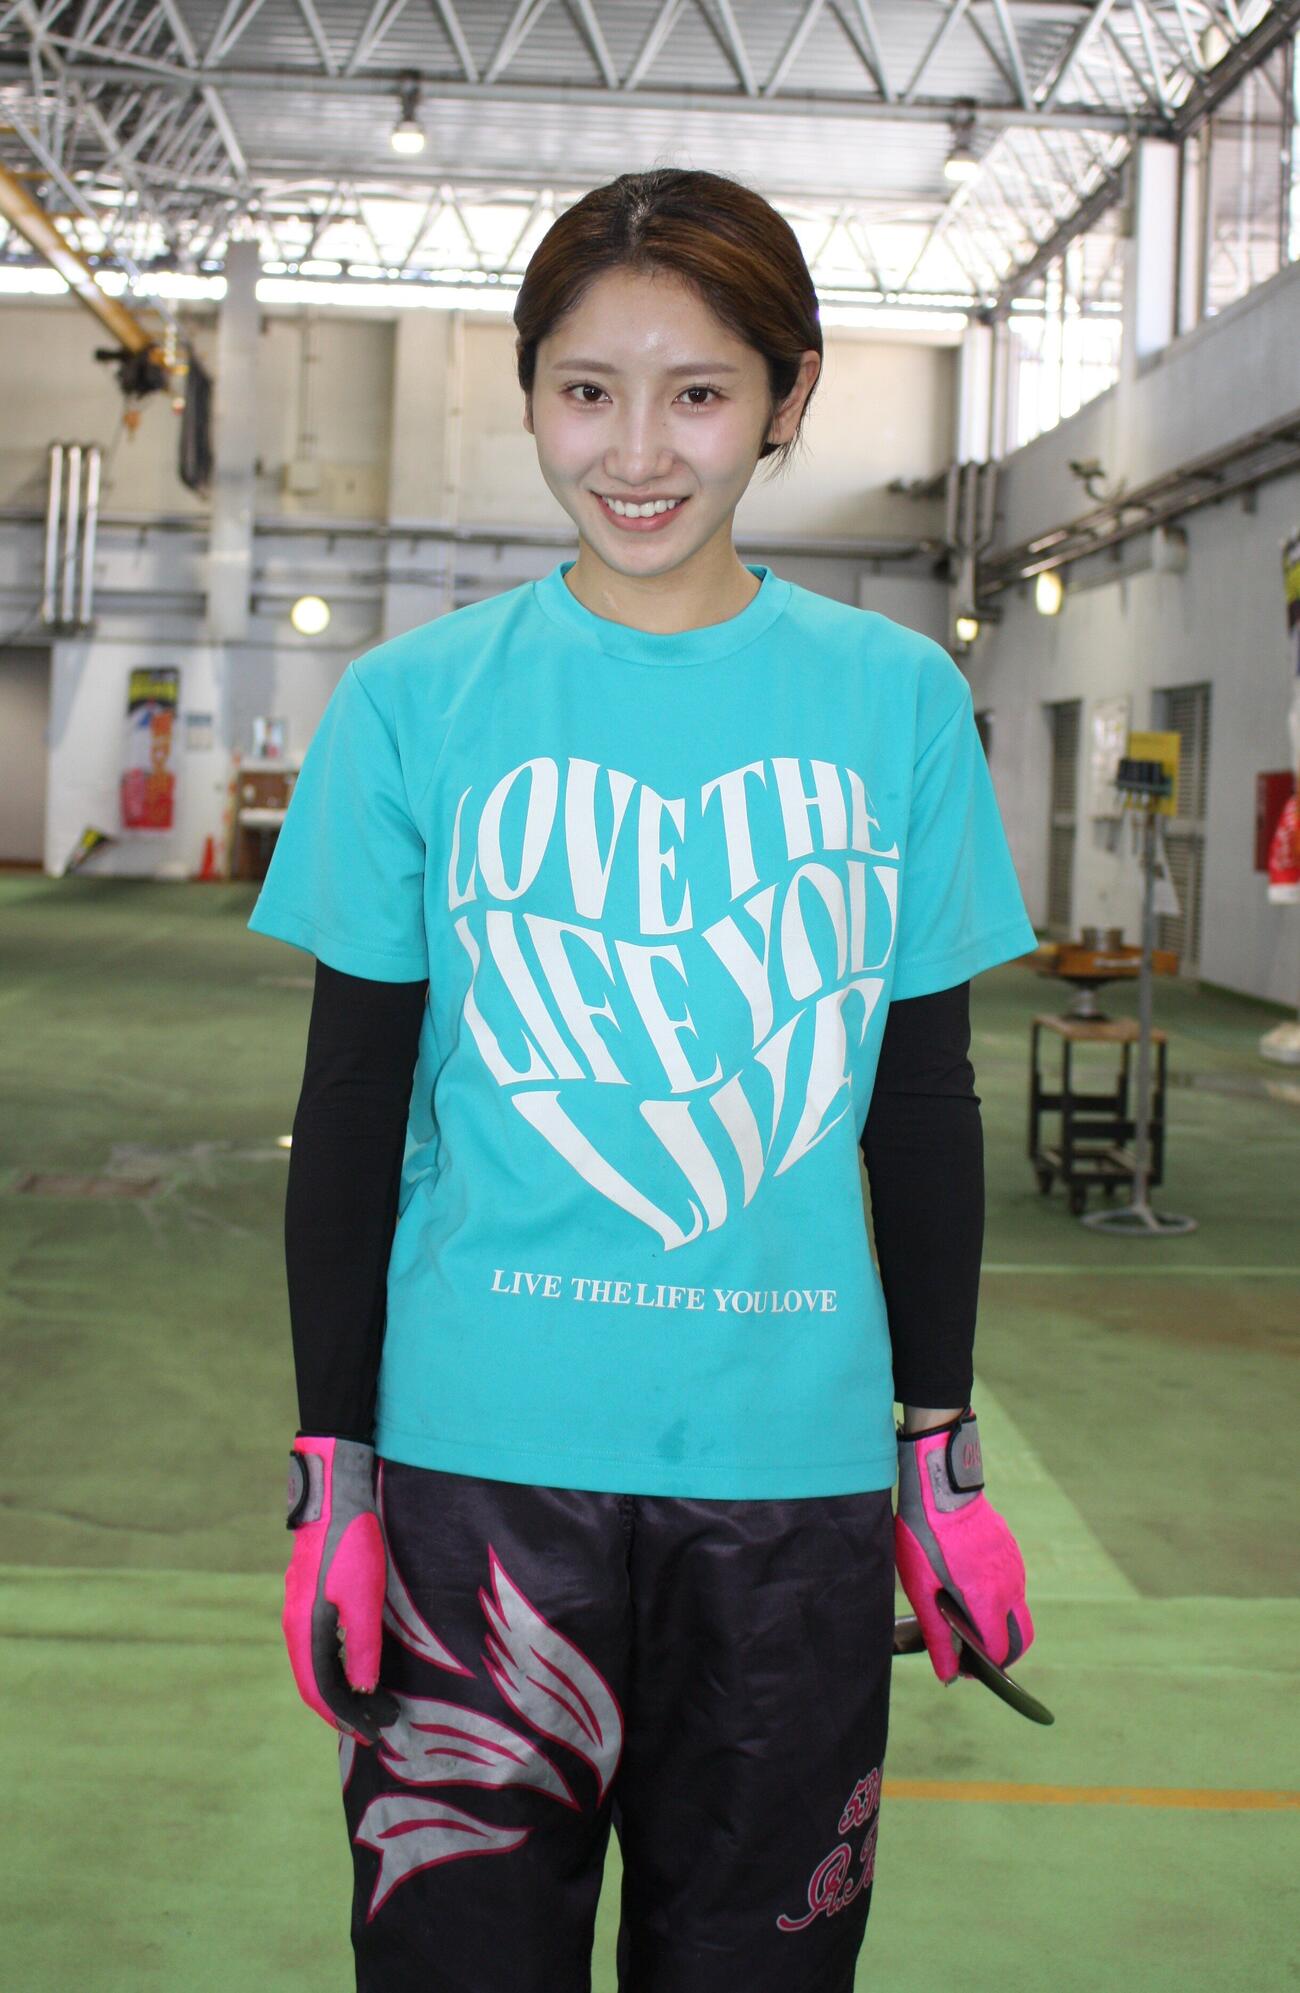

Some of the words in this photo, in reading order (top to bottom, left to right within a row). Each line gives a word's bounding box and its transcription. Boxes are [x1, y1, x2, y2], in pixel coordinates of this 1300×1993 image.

[447, 757, 693, 936] LOVE
[701, 757, 901, 902] THE
[454, 910, 724, 1093] LIFE
[701, 861, 899, 1050] YOU
[511, 977, 886, 1252] LIVE
[490, 1269, 562, 1298] LIVE
[571, 1277, 632, 1305] THE
[634, 1283, 705, 1311] LIFE
[712, 1288, 770, 1313] YOU
[770, 1289, 838, 1314] LOVE
